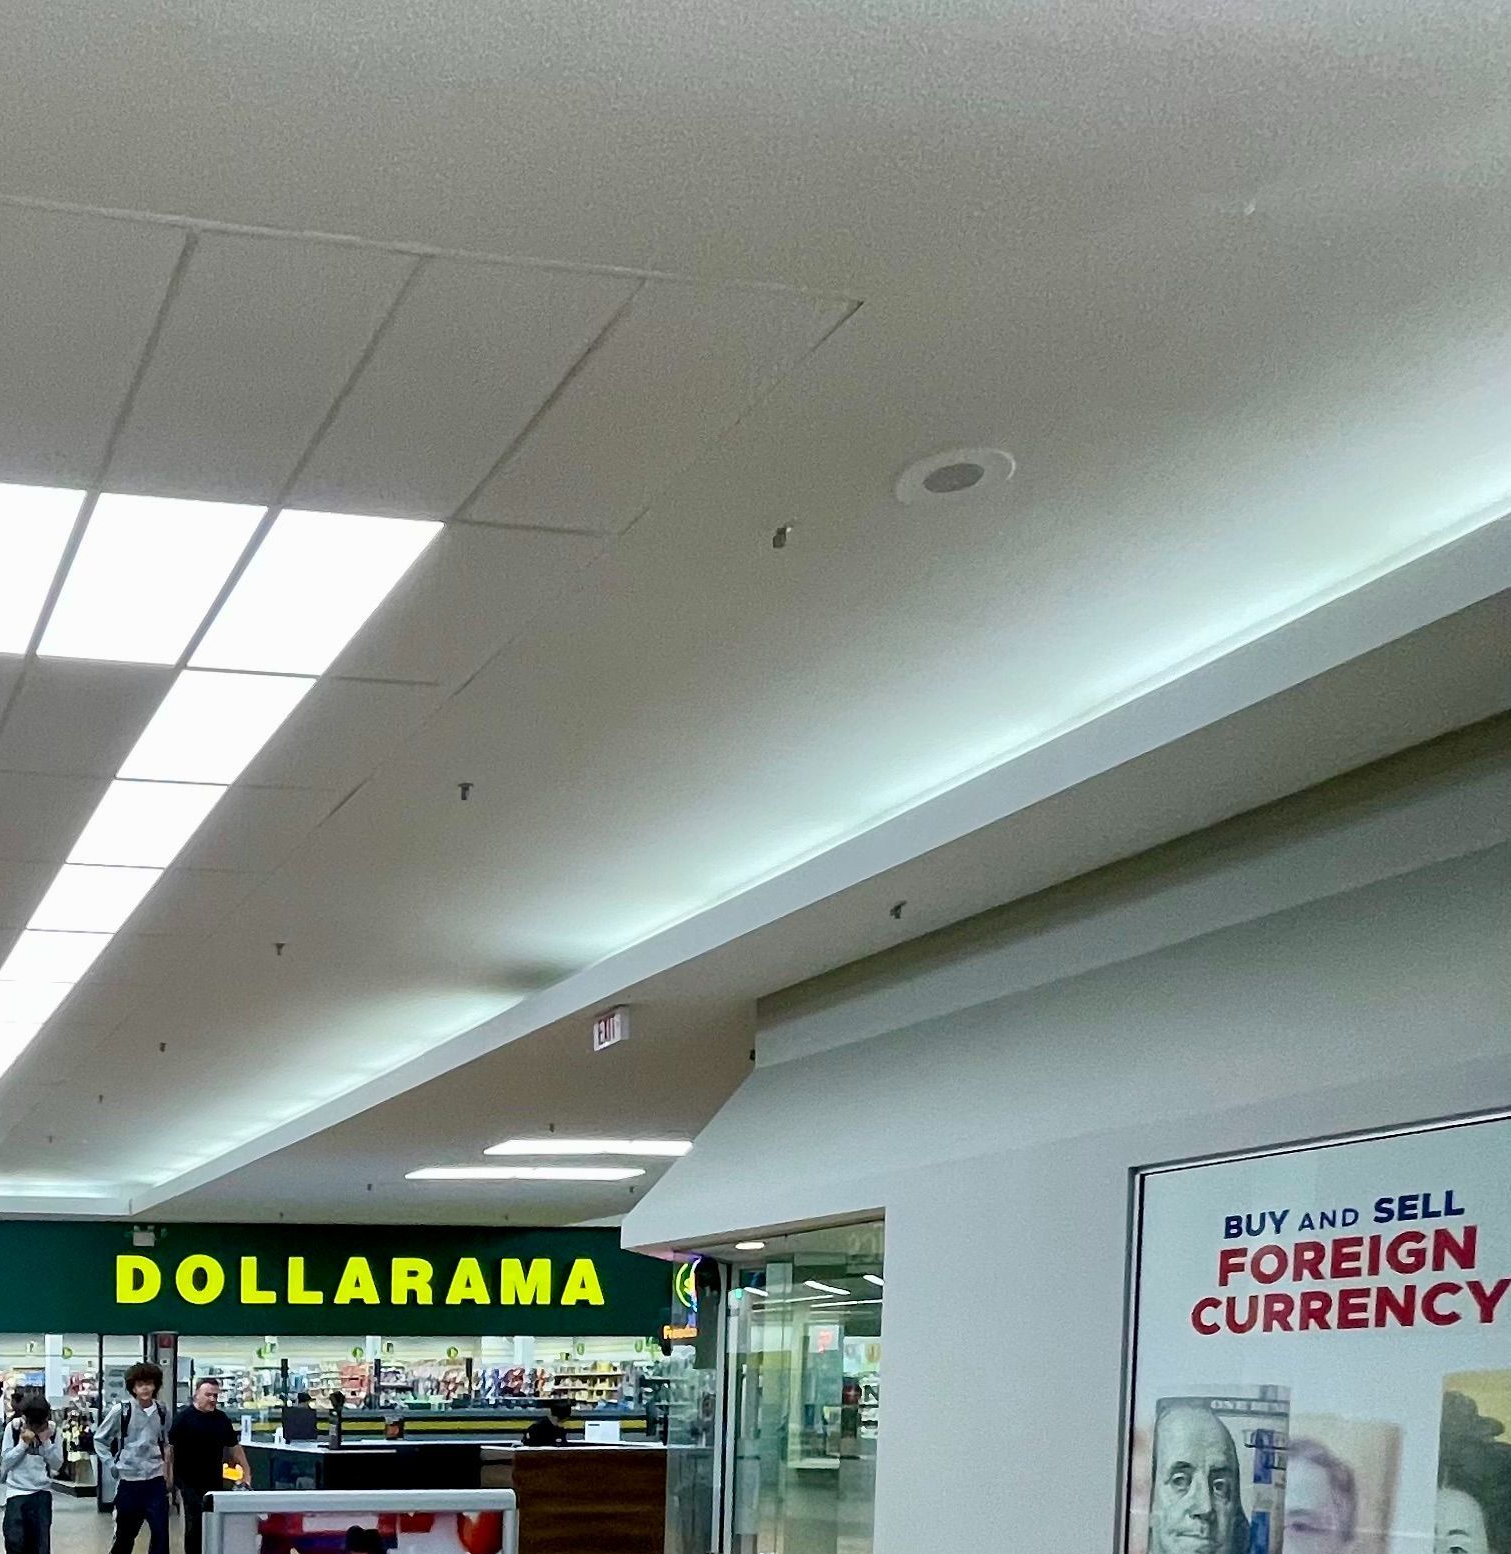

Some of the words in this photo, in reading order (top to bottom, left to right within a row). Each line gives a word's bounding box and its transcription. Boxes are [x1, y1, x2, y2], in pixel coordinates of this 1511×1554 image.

[1224, 1209, 1290, 1239] BUY
[1298, 1208, 1359, 1231] AND
[1374, 1190, 1465, 1223] SELL
[117, 1255, 604, 1306] DOLLARAMA
[1218, 1225, 1477, 1287] FOREIGN
[1191, 1278, 1511, 1336] CURRENCY
